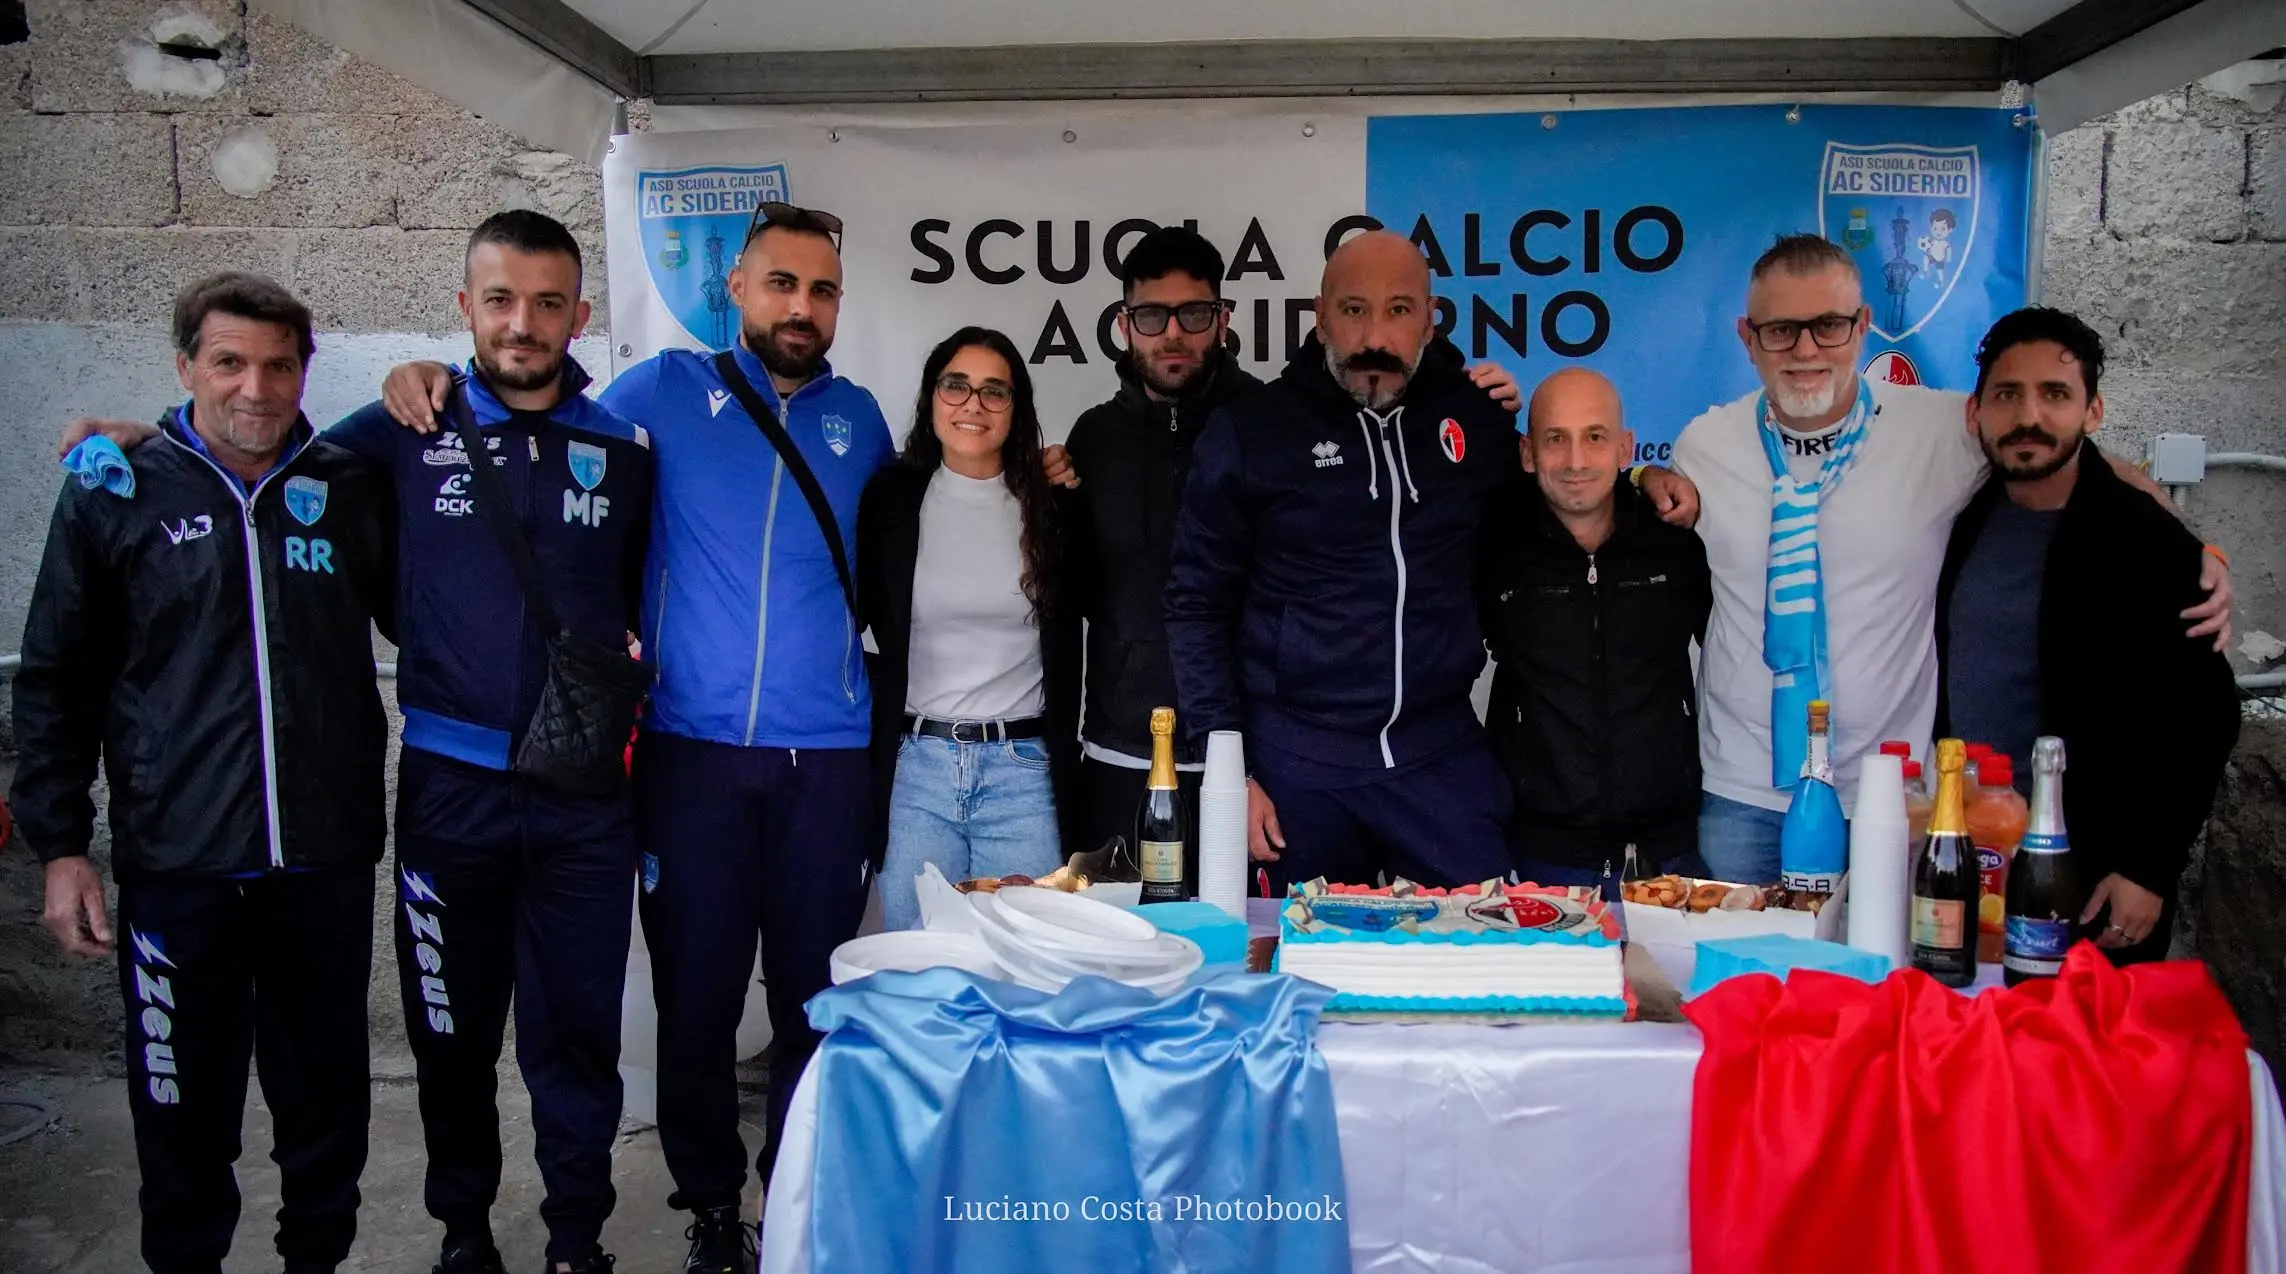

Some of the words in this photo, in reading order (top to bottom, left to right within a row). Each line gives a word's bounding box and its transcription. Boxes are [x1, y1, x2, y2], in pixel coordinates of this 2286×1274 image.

[1840, 157, 1863, 169] ASD
[1867, 157, 1914, 170] SCUOLA
[1919, 159, 1963, 172] CALCIO
[650, 180, 674, 192] ASD
[677, 177, 726, 191] SCUOLA
[730, 175, 774, 188] CALCIO
[1832, 171, 1863, 192] AC
[1869, 172, 1967, 195] SIDERNO
[646, 194, 674, 215] AC
[434, 497, 474, 514] DCK
[563, 488, 610, 528] MF
[286, 536, 334, 574] RR
[405, 902, 454, 1034] Zeus
[135, 964, 180, 1104] Zeus
